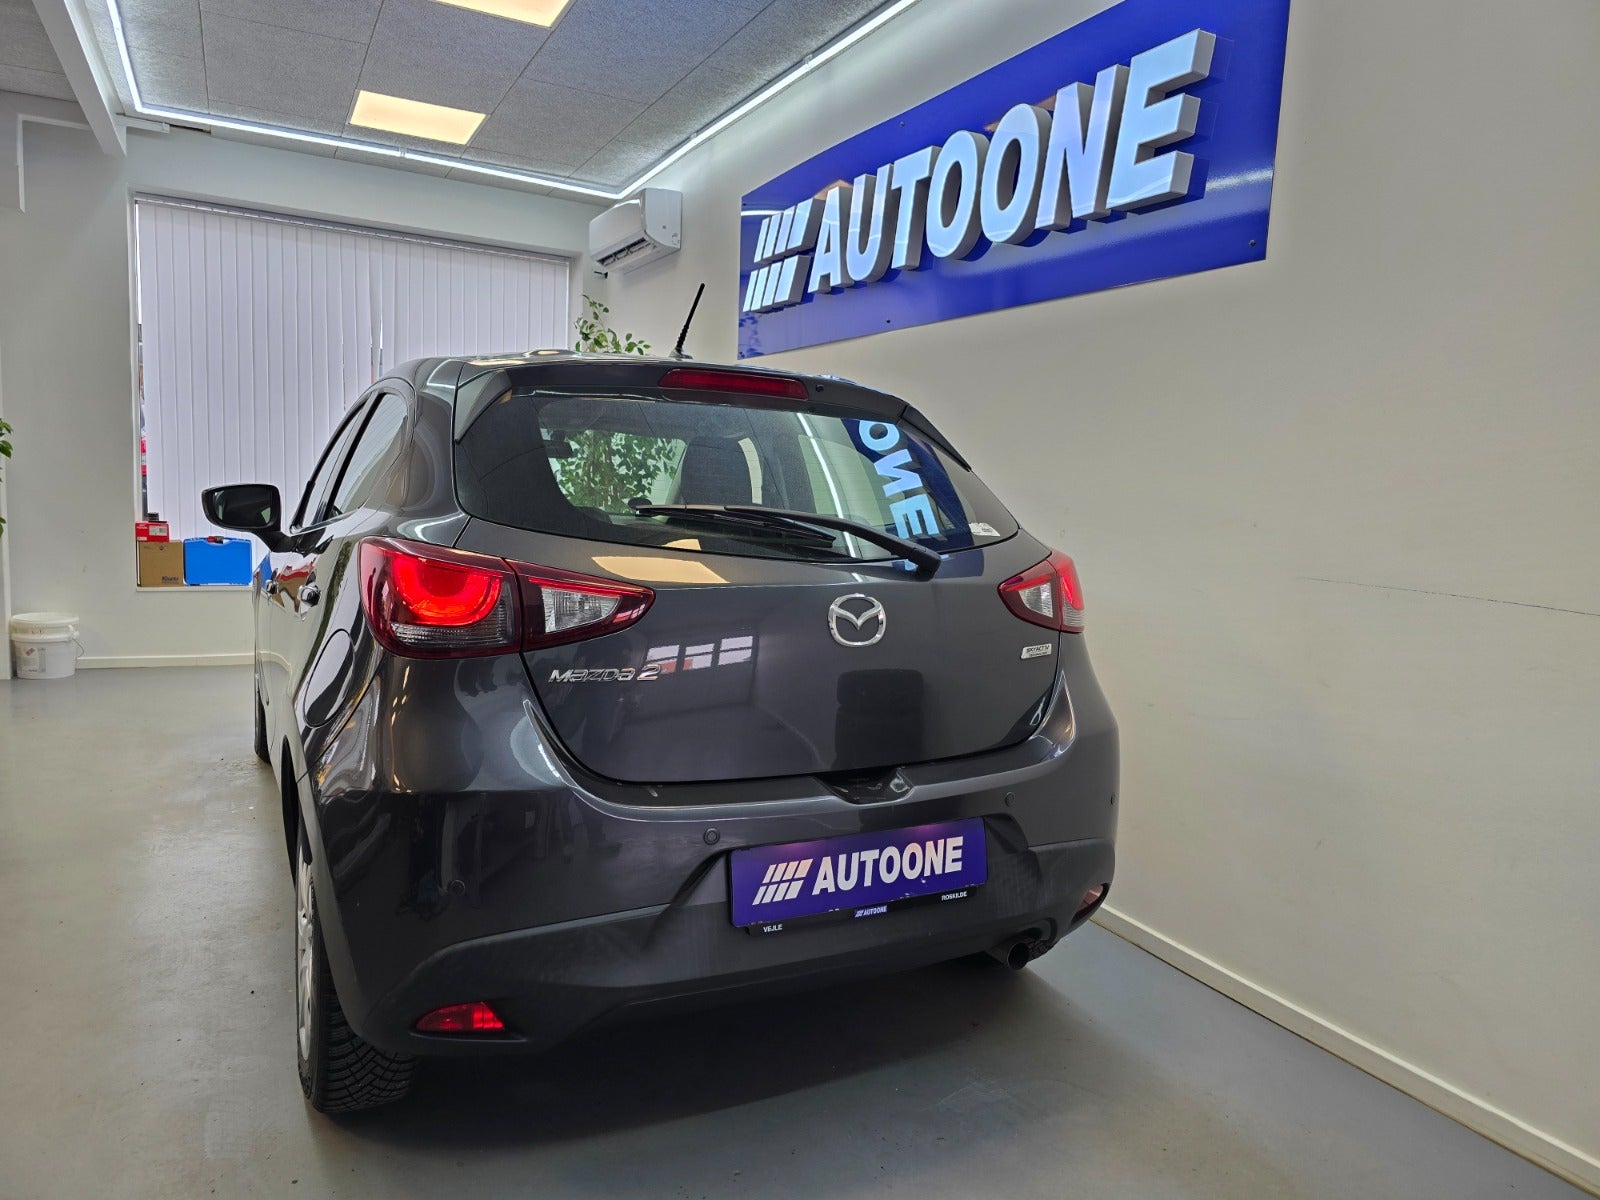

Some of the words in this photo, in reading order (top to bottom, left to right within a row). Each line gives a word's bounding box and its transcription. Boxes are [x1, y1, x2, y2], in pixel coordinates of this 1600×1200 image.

[808, 28, 1216, 293] AUTOONE
[637, 663, 661, 682] 2
[812, 836, 964, 896] AUTOONE
[863, 905, 888, 917] AUTOONE
[762, 924, 783, 933] VEJLE
